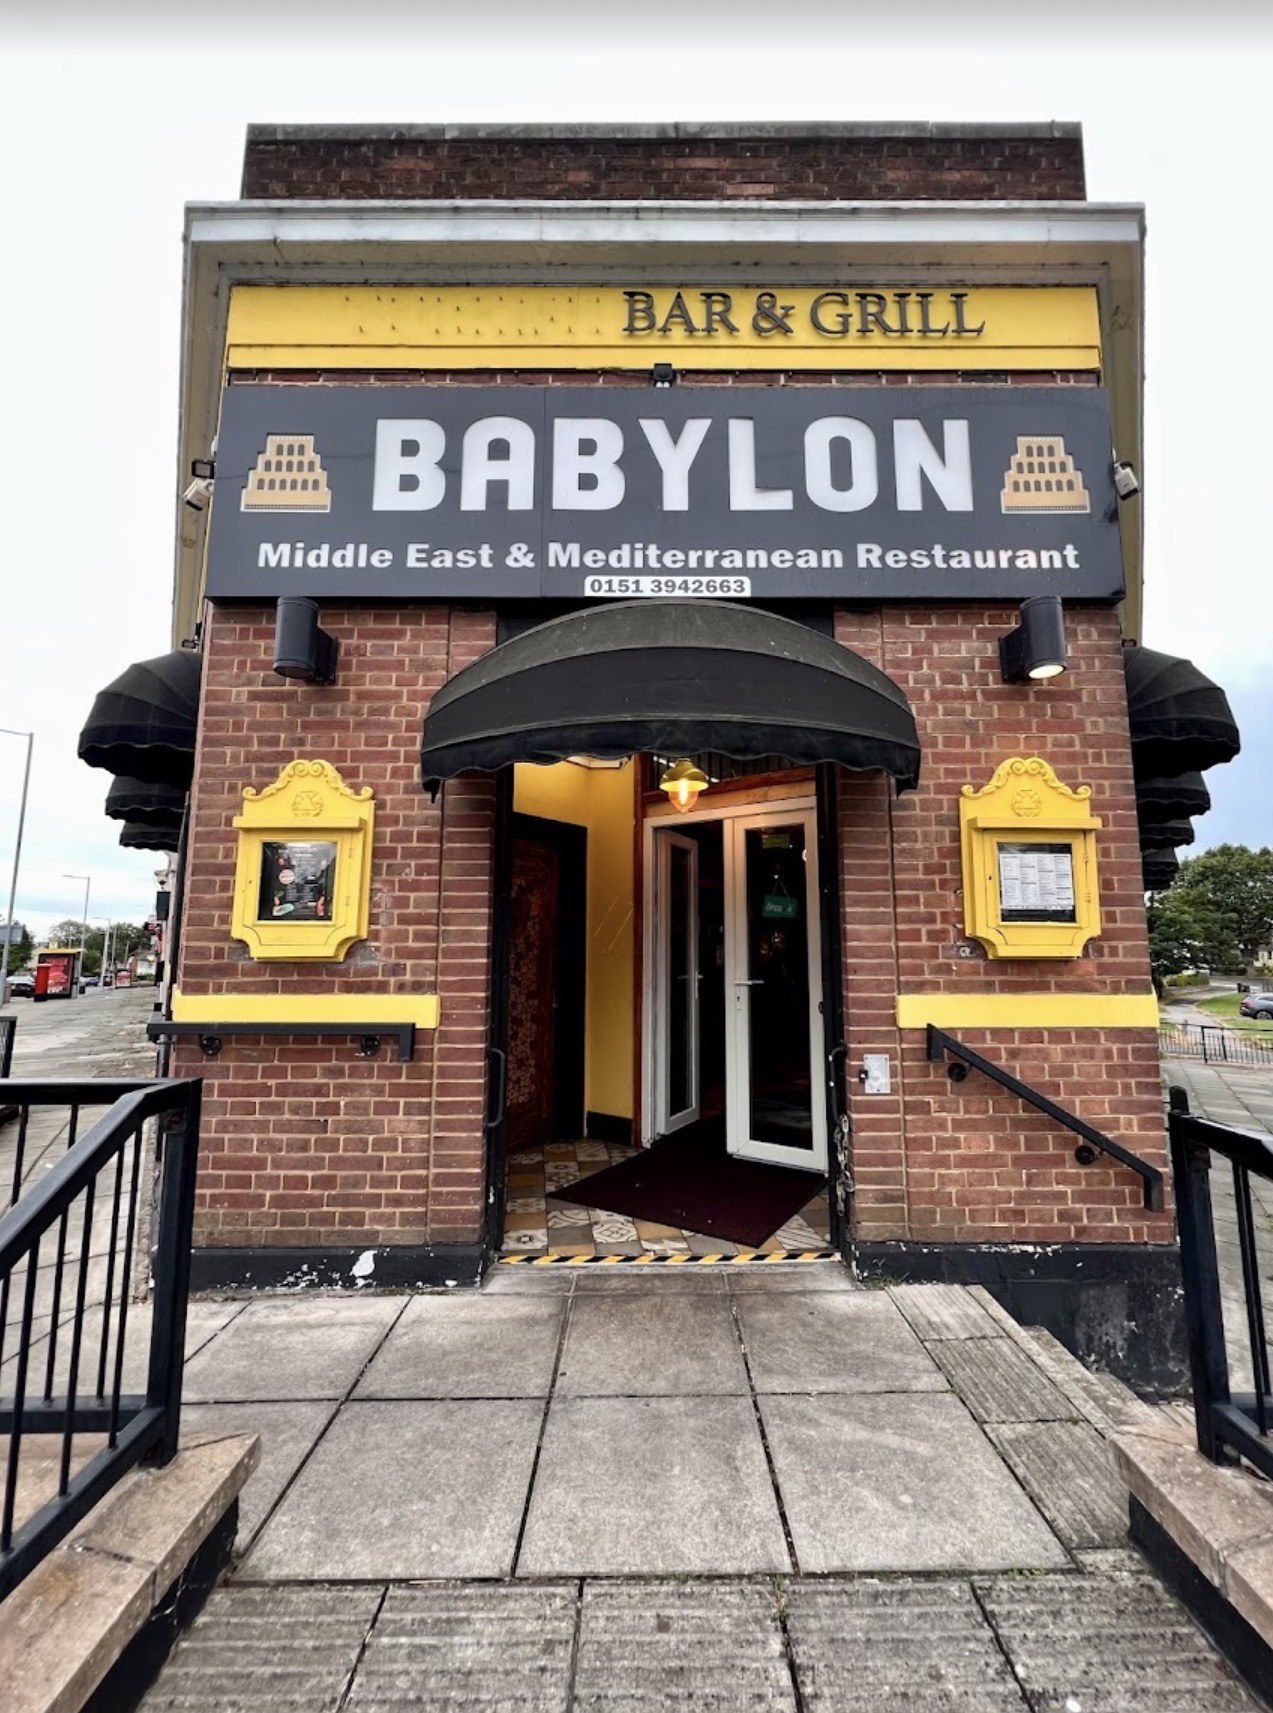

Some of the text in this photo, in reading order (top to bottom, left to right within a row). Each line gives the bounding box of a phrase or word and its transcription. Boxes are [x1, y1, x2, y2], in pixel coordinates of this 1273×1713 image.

[623, 291, 985, 336] BAR & GRILL
[373, 417, 973, 512] BABYLON
[258, 543, 1079, 569] Middle East & Mediterranean Restaurant
[591, 580, 744, 593] 0151 3942663
